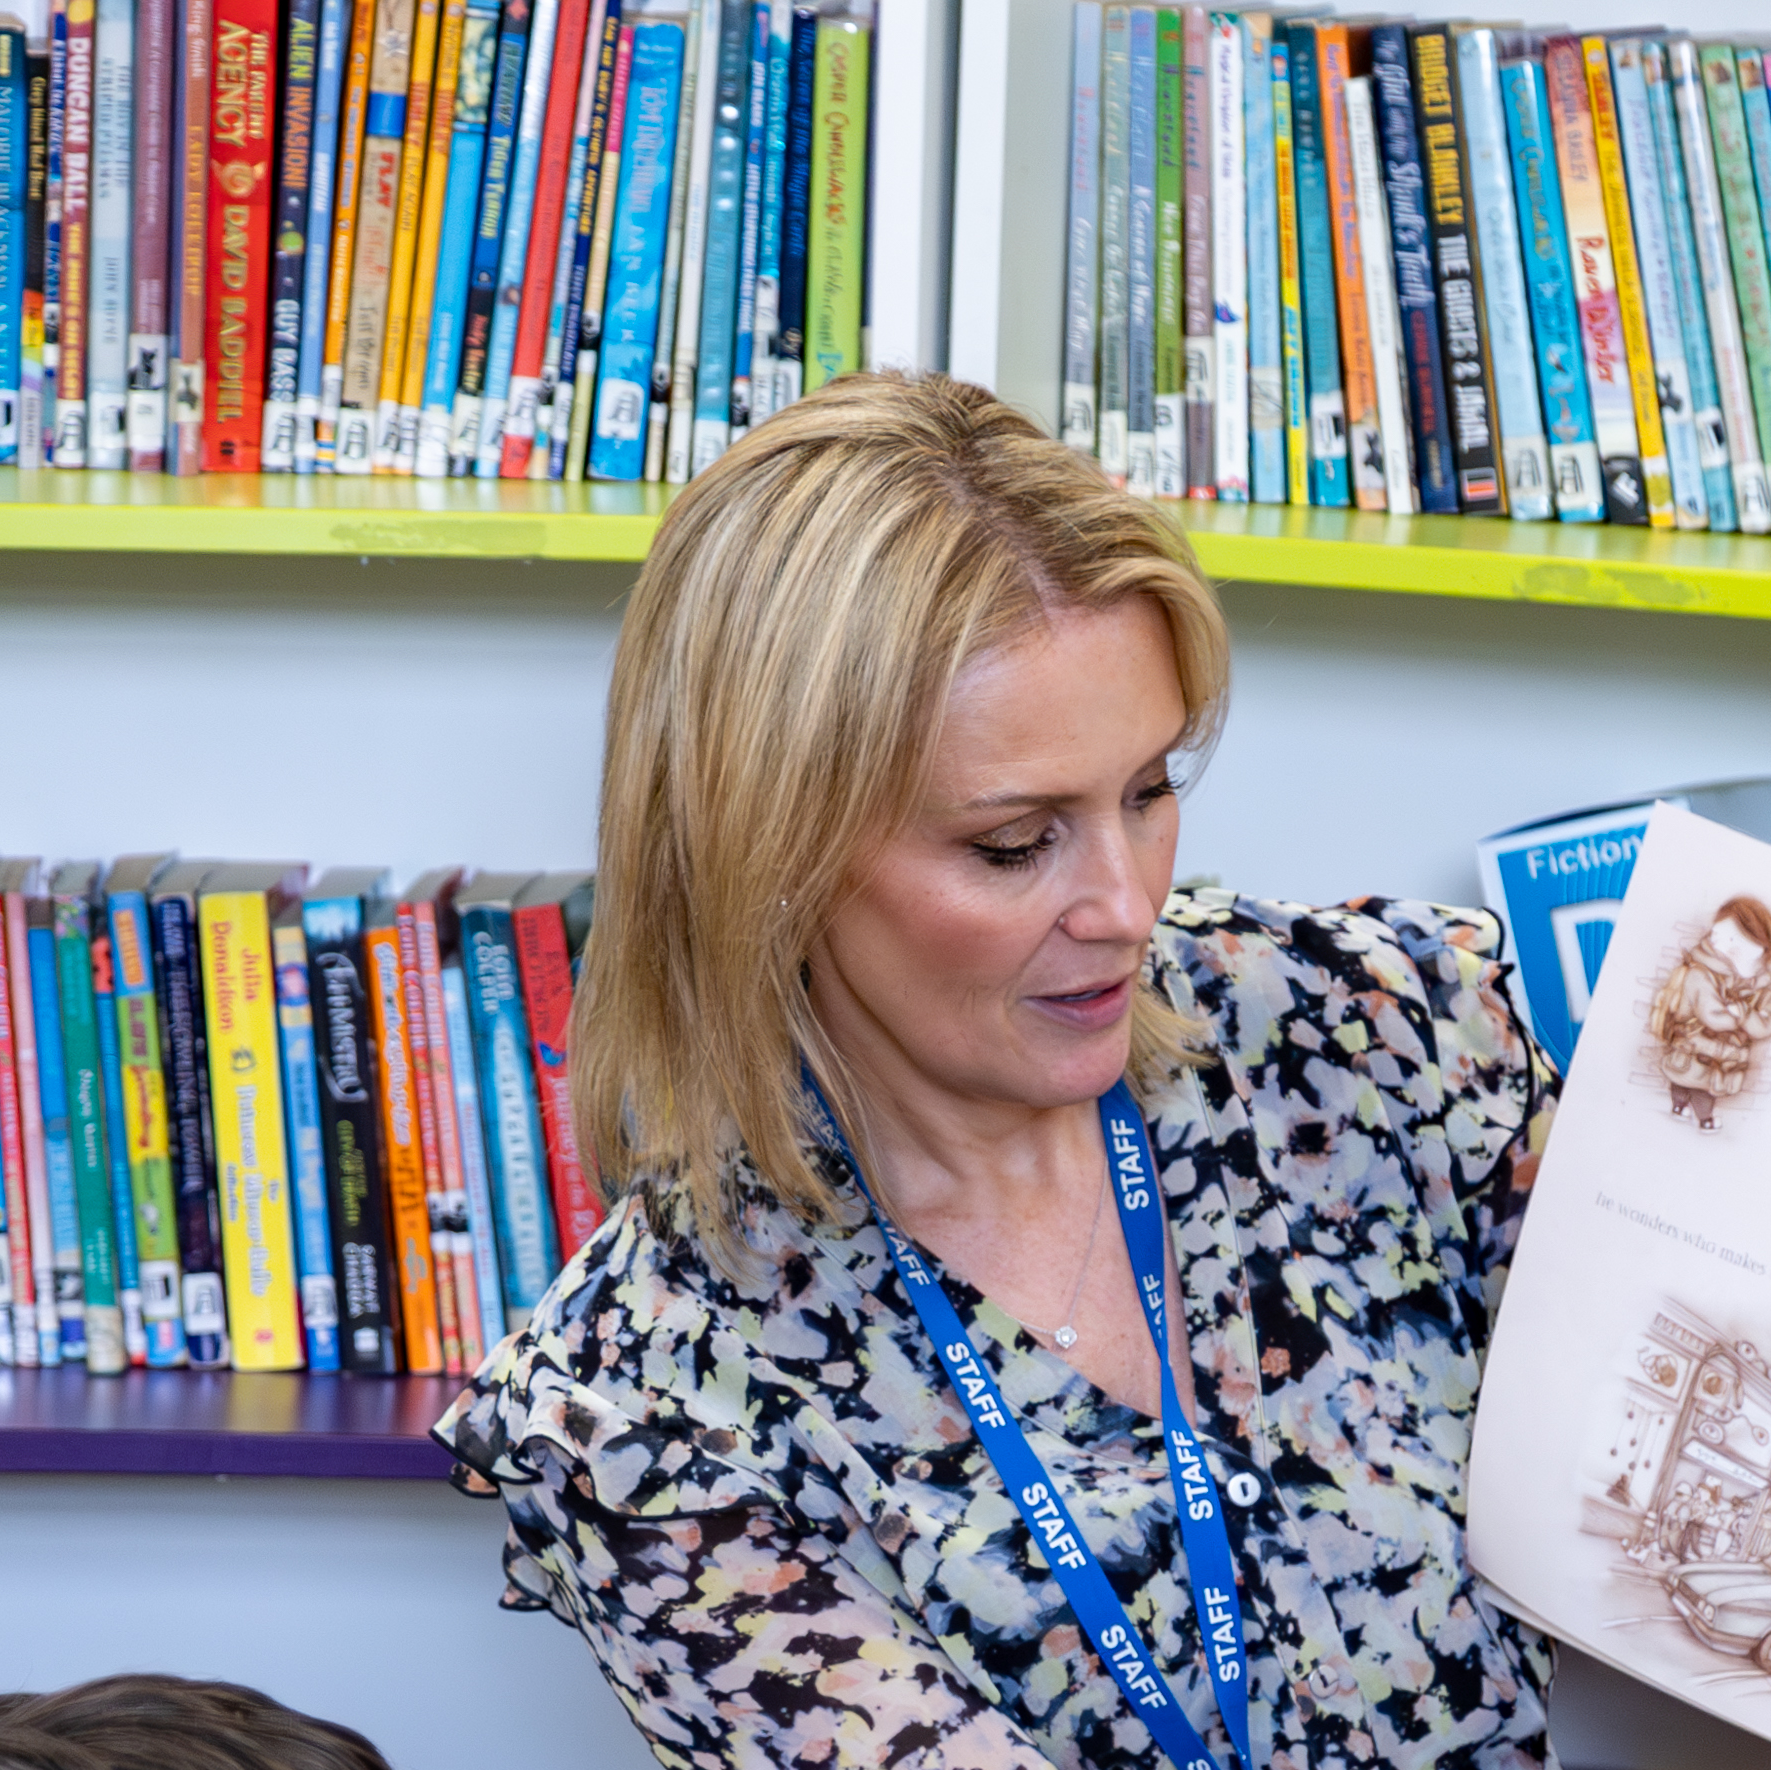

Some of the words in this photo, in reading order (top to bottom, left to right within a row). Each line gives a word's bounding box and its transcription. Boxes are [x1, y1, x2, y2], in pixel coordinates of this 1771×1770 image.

[66, 36, 90, 145] DUNCAN
[214, 19, 251, 149] AGENCY
[249, 31, 270, 66] THE
[288, 17, 317, 80] ALIEN
[825, 42, 851, 103] CASPER
[1373, 61, 1411, 109] Girl
[1414, 32, 1451, 122] BRIDGET
[247, 70, 268, 140] PARENT
[281, 85, 312, 189] INVASION!
[63, 151, 90, 215] BALL
[579, 168, 599, 236] ADVENTURE
[822, 110, 852, 226] CANDLEWACKS
[1423, 122, 1466, 227] BLANKLEY
[220, 204, 250, 290] DAVID
[1436, 232, 1469, 277] THE
[1575, 234, 1608, 299] Raven
[216, 296, 248, 424] BADDIEL
[273, 299, 301, 343] GUY
[1441, 279, 1477, 359] GHOSTS
[1589, 305, 1618, 386] Winter
[1453, 361, 1480, 381] &
[1457, 384, 1488, 455] JAMAL
[1526, 836, 1643, 879] Fiction
[211, 921, 236, 1031] Donaldson
[241, 947, 262, 1001] Julia
[472, 931, 499, 1016] COLFER
[493, 945, 515, 1000] EOIN
[235, 1085, 258, 1168] Princess
[550, 1078, 581, 1164] Journey
[1108, 1116, 1150, 1211] STAFF
[1594, 1189, 1618, 1212] he
[1618, 1200, 1680, 1242] wonders
[1682, 1228, 1718, 1255] who
[1718, 1242, 1767, 1278] makes
[944, 1340, 1007, 1431] STAFF
[1169, 1428, 1215, 1522] STAFF
[1020, 1481, 1088, 1572] STAFF
[1100, 1623, 1168, 1712] STAFF
[1201, 1585, 1243, 1683] STAFF
